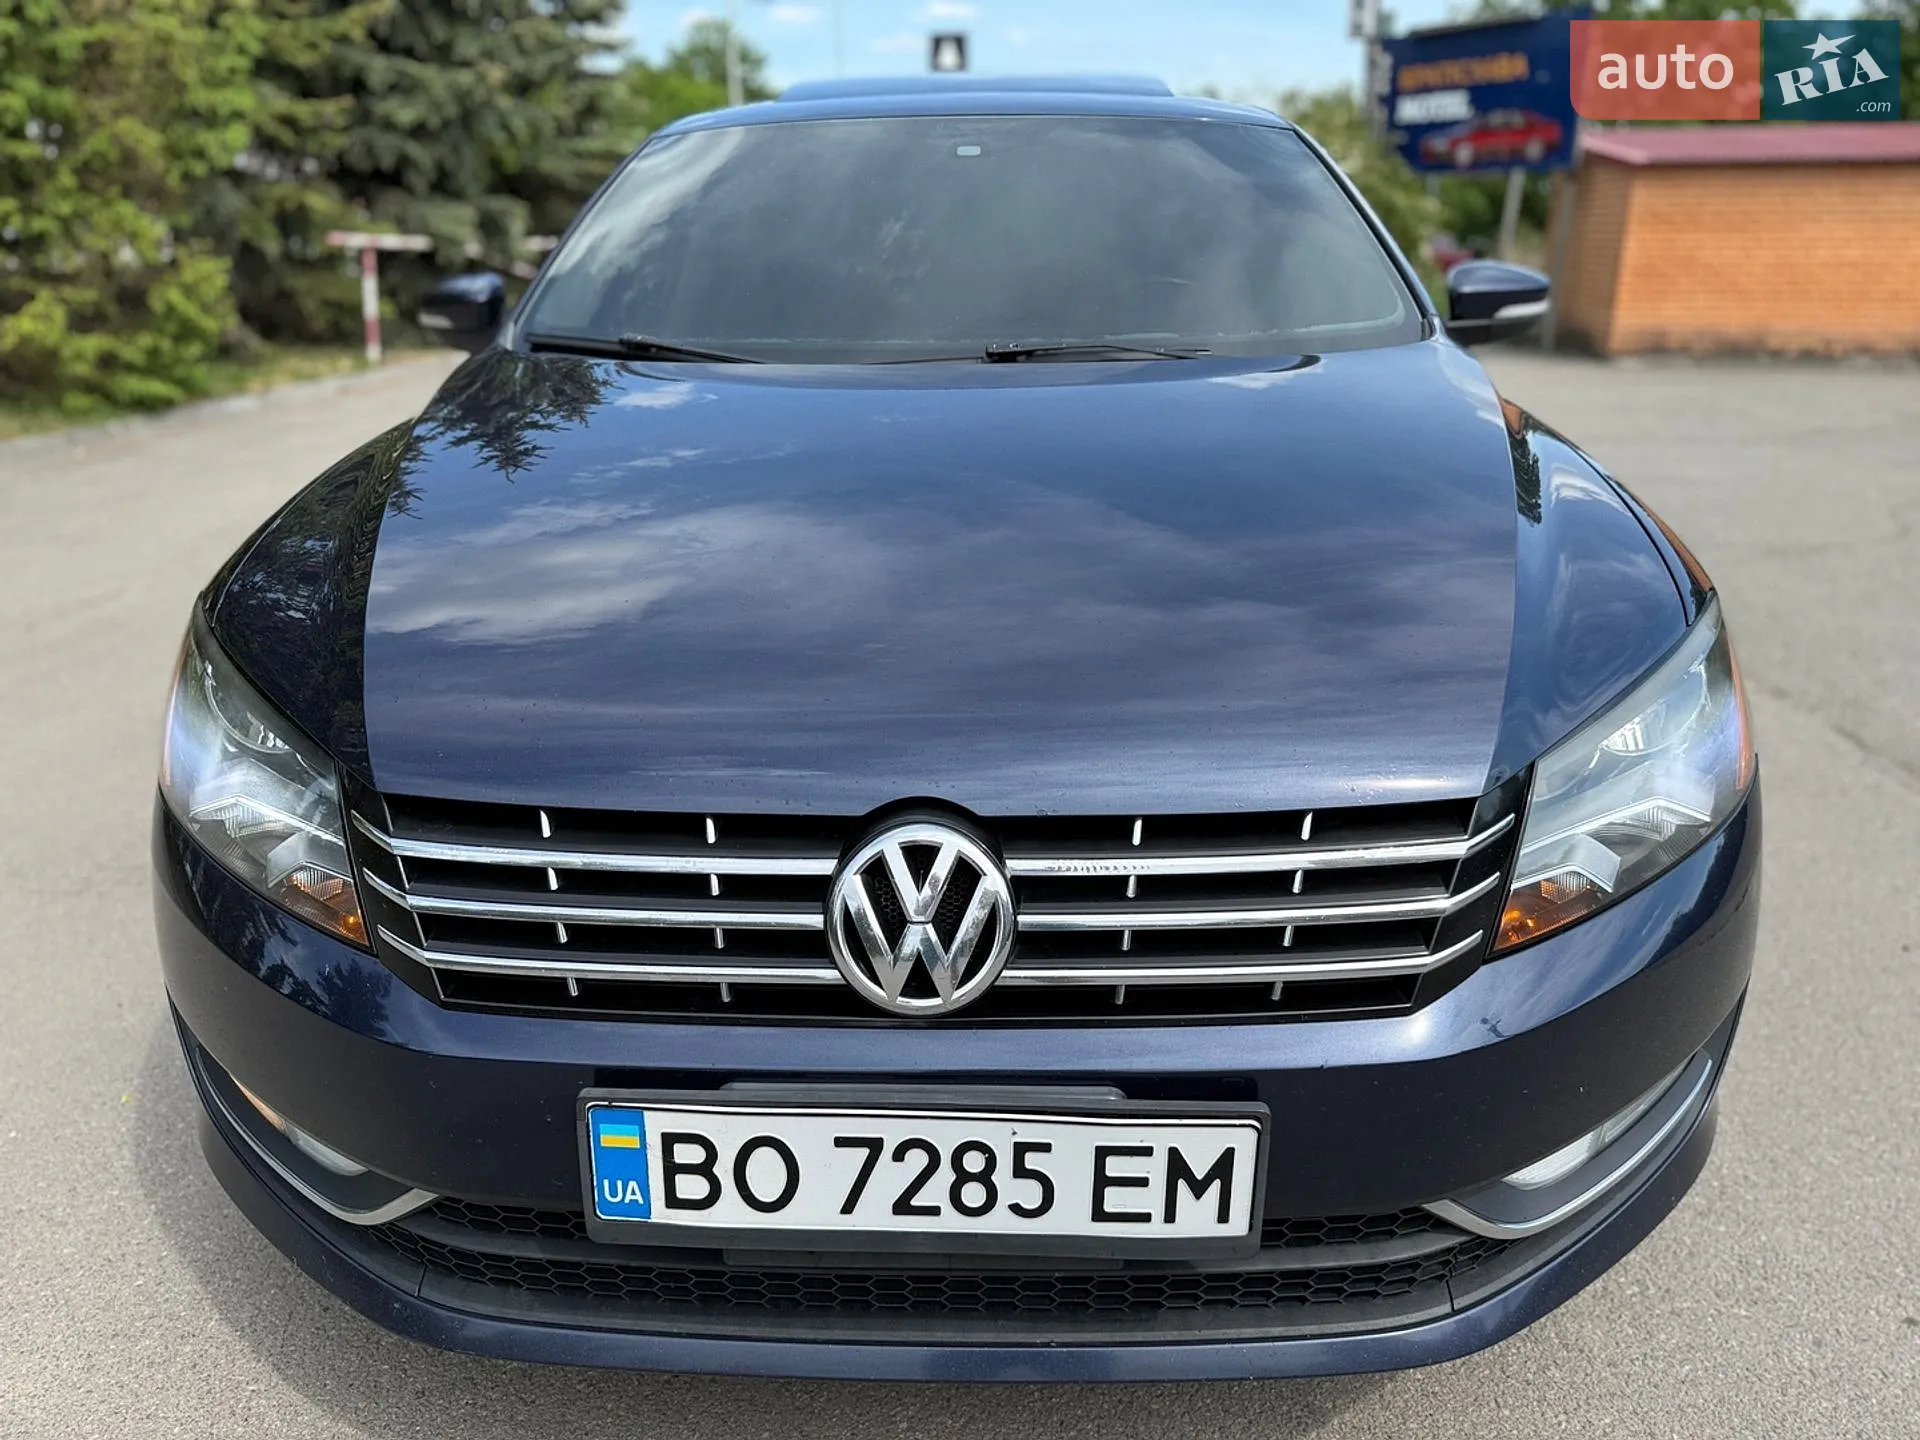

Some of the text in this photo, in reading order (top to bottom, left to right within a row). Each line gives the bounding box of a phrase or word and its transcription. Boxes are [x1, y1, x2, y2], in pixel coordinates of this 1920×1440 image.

[603, 1179, 643, 1204] UA
[661, 1131, 1236, 1223] BO 7285 EM
